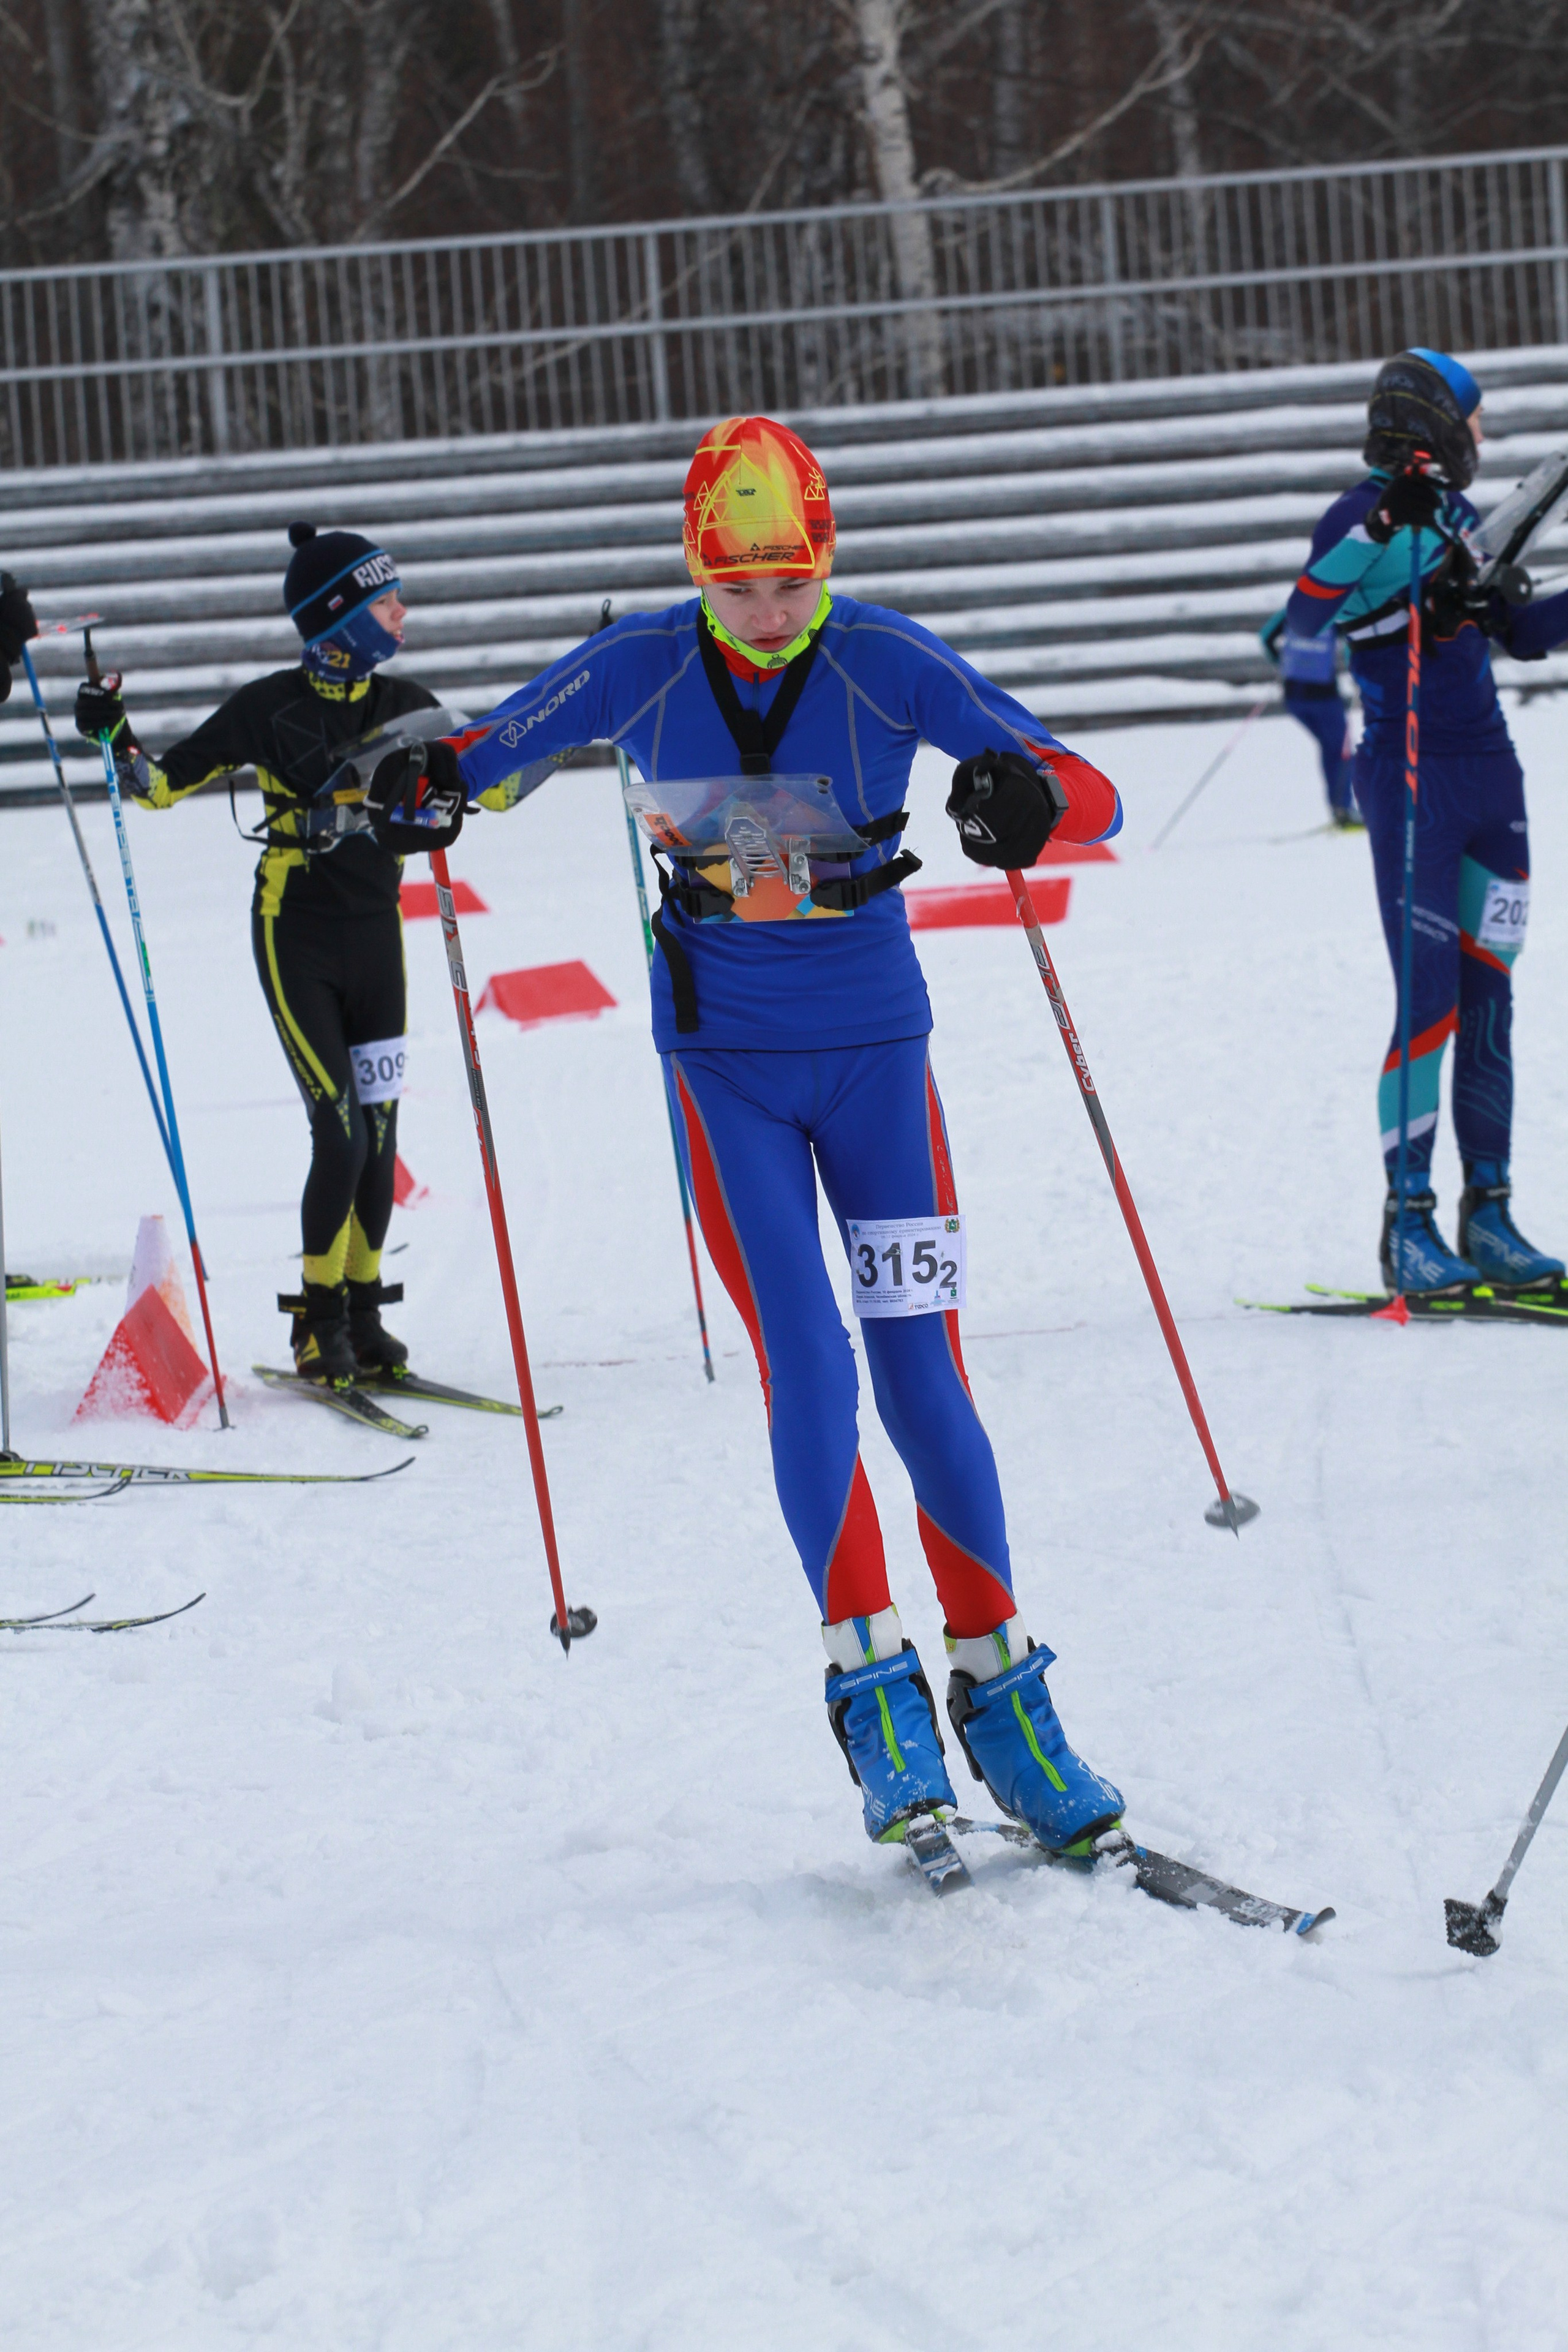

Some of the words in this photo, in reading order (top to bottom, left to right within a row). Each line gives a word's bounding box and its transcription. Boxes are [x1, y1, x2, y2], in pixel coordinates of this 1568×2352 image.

[714, 552, 795, 565] FISCHER
[527, 670, 590, 730] NORD
[1405, 603, 1421, 805] PILOT
[1069, 1031, 1095, 1092] Cyber
[840, 1660, 908, 1691] SPINE
[987, 1656, 1044, 1697] SPINE
